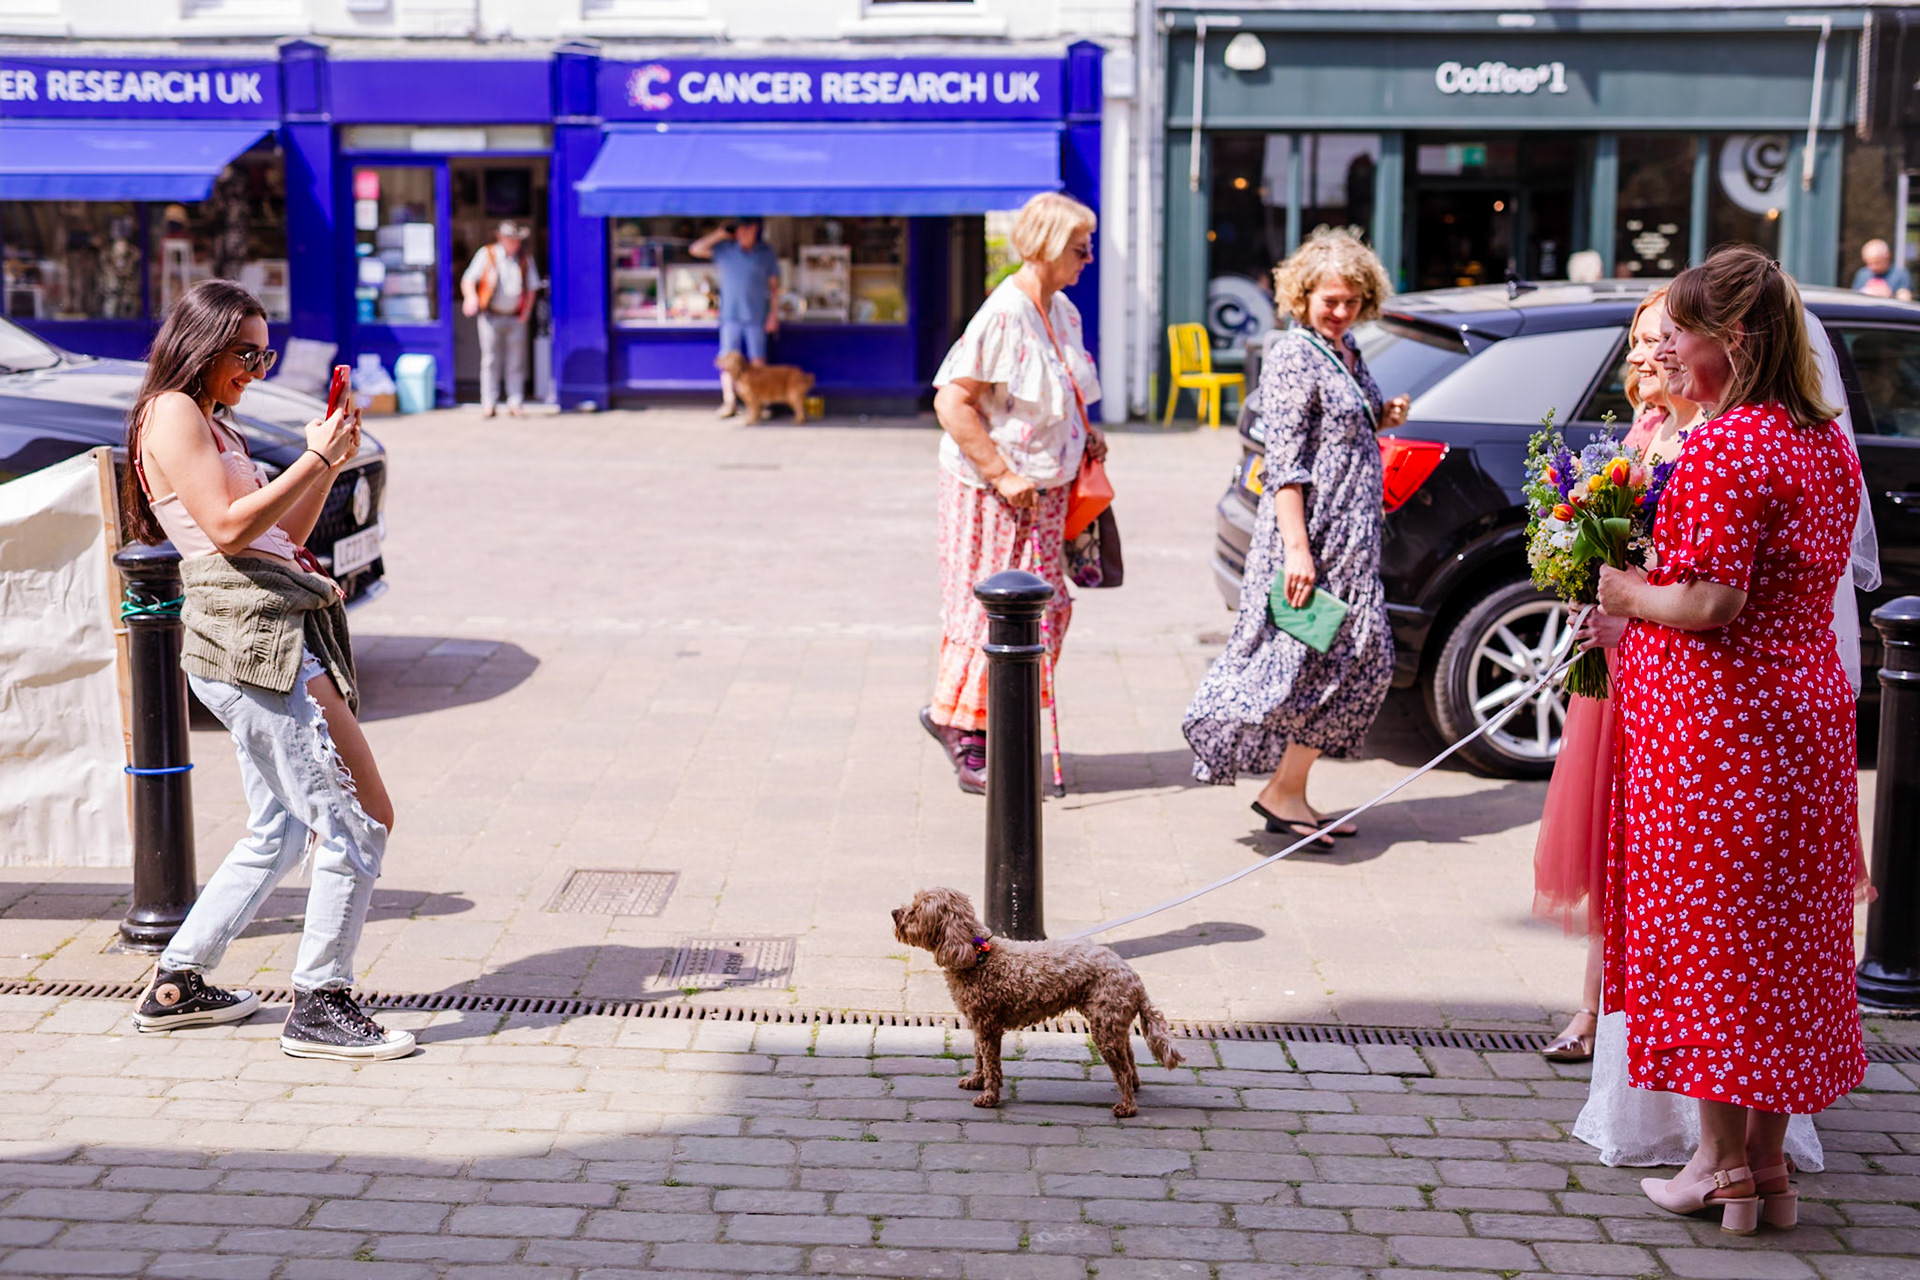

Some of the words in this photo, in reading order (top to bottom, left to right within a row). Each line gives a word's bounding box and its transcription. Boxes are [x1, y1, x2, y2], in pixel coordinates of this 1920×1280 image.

[47, 70, 210, 103] RESEARCH
[215, 72, 263, 104] UK
[678, 71, 813, 104] CANCER
[821, 71, 988, 104] RESEARCH
[993, 71, 1041, 104] UK
